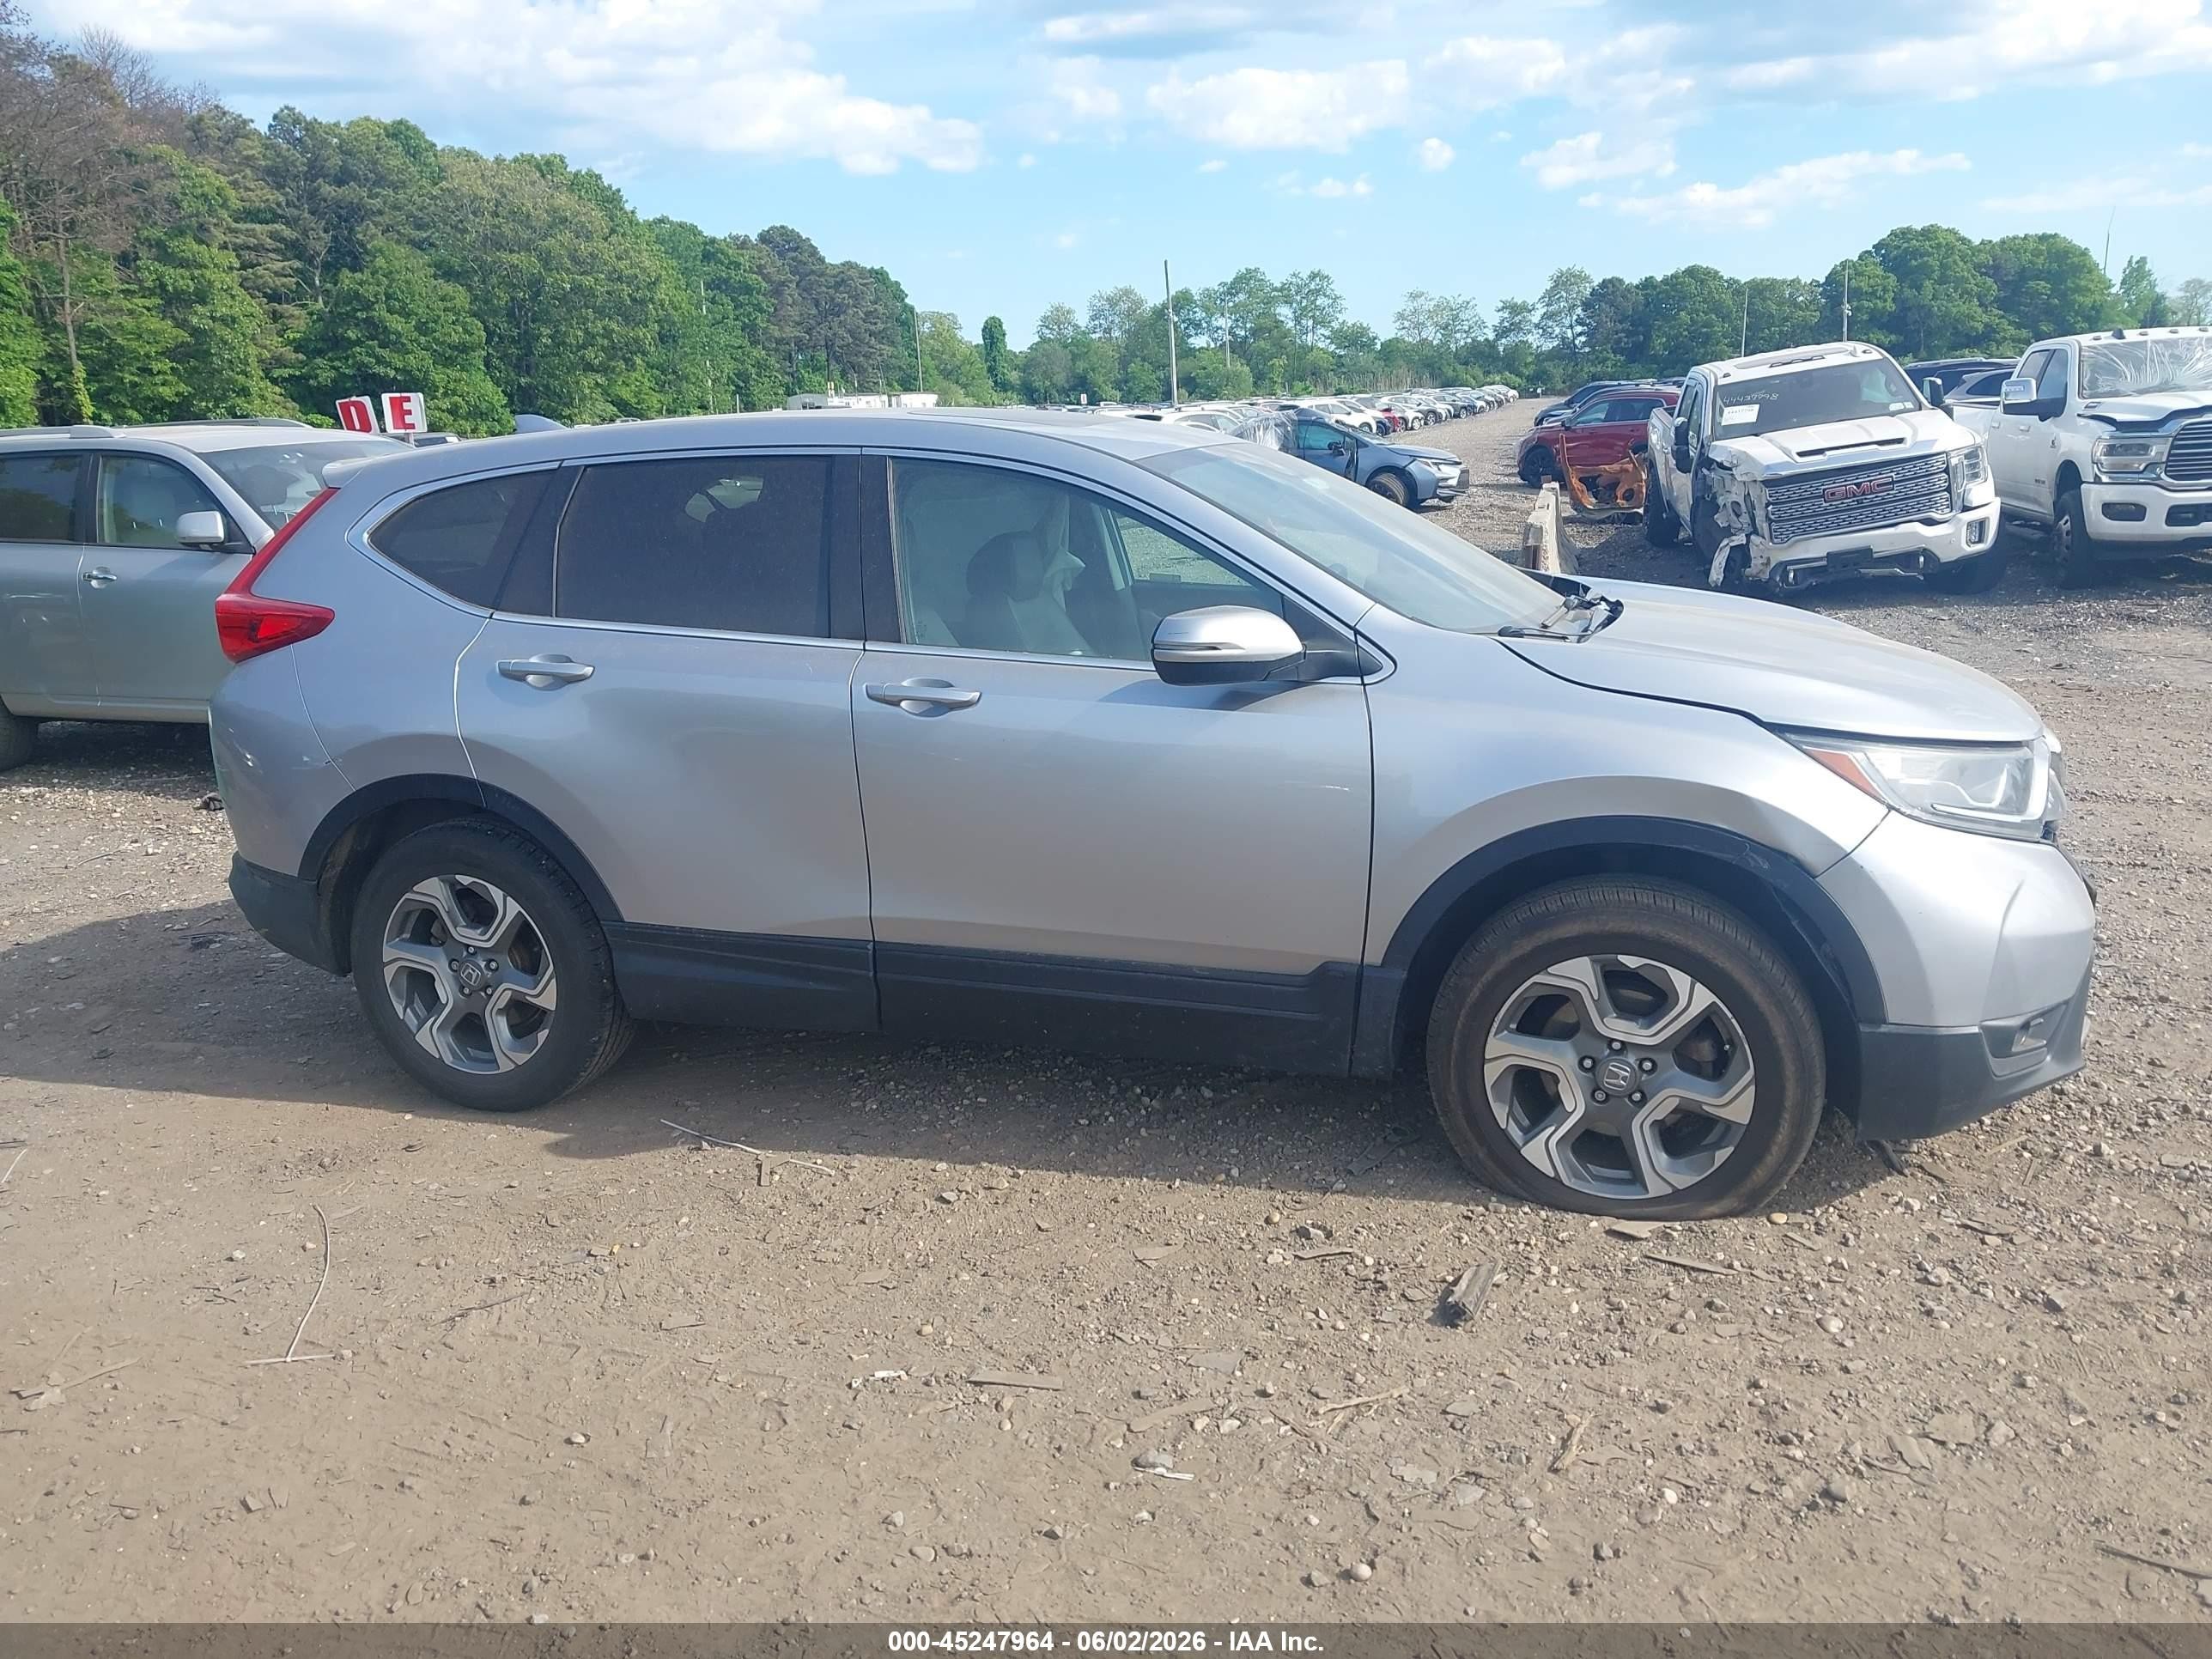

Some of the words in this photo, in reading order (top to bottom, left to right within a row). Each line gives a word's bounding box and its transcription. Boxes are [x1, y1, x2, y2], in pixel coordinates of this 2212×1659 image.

[338, 400, 372, 433] D
[389, 396, 416, 429] E
[1825, 477, 1893, 501] GMC
